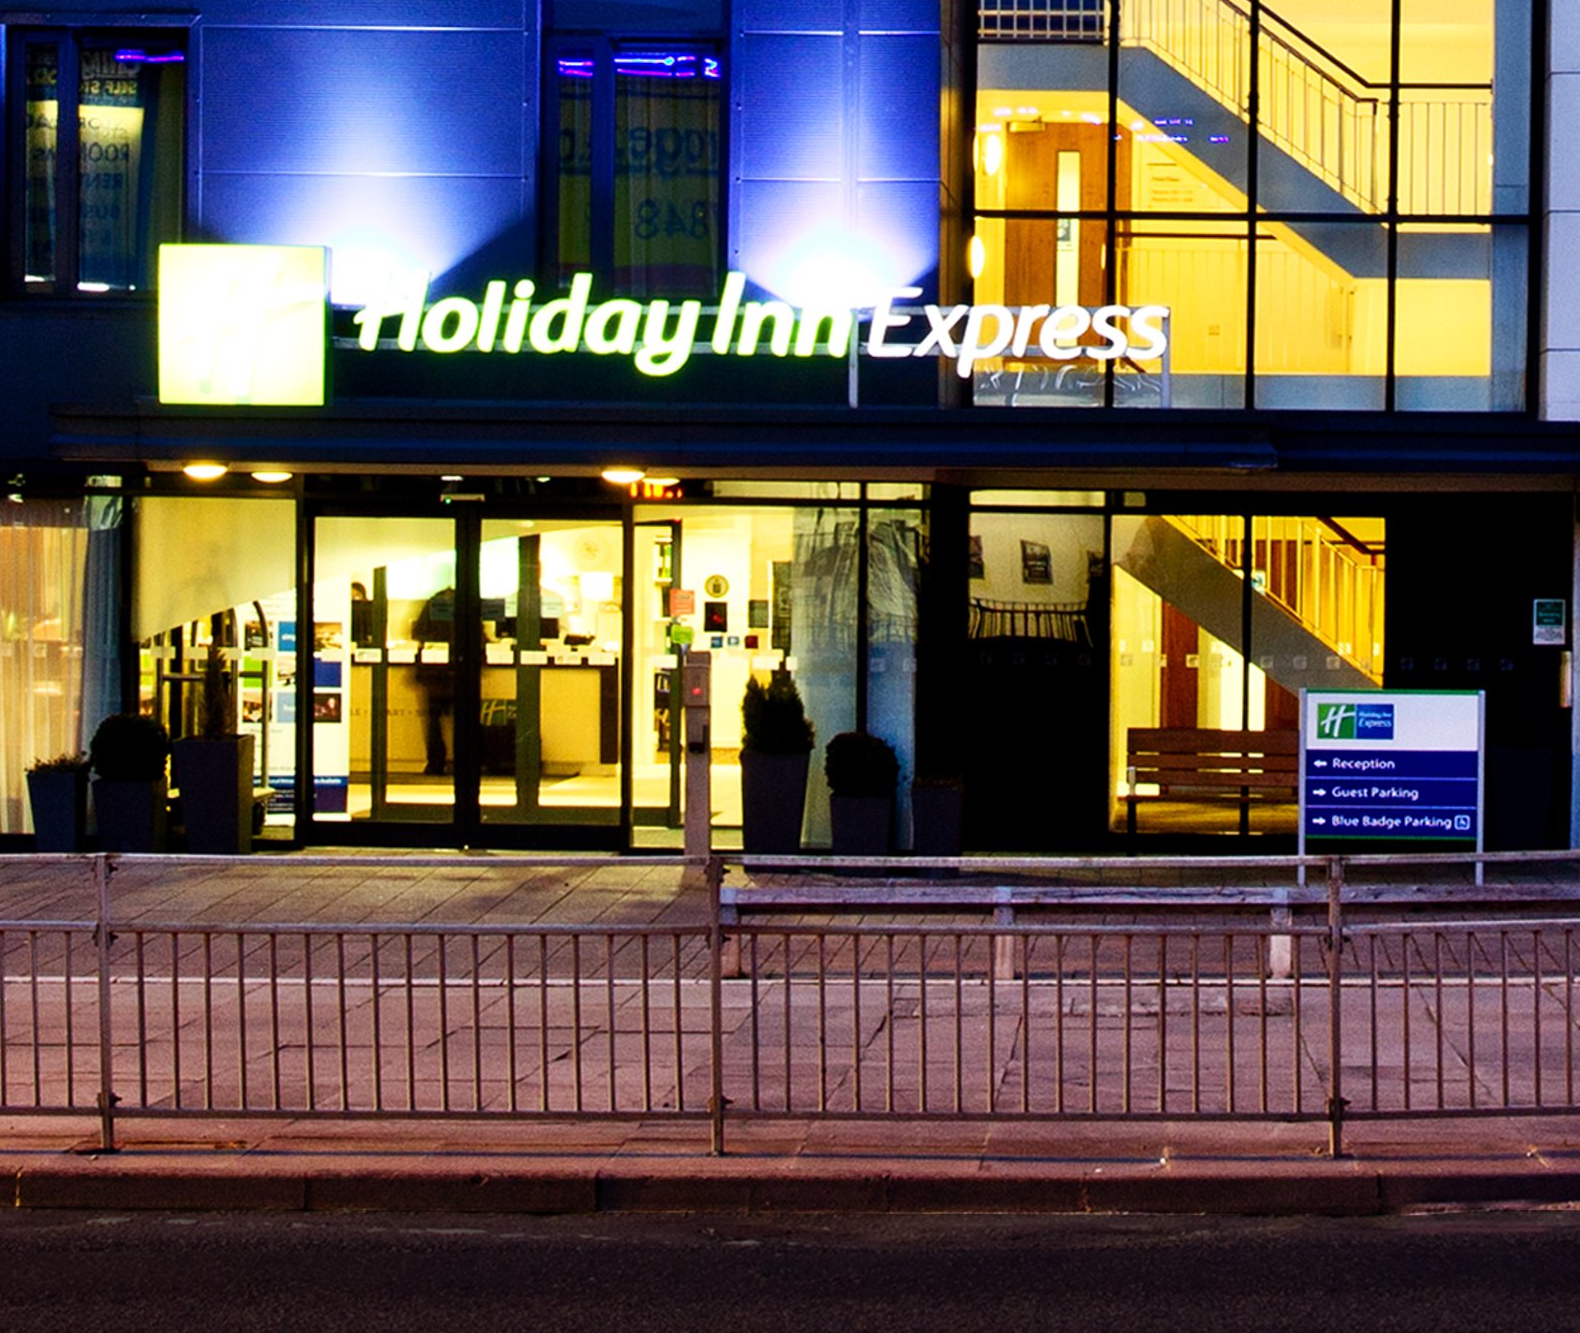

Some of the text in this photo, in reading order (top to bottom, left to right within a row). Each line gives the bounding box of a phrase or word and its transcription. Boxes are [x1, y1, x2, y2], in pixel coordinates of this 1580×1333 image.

[352, 270, 1170, 379] Holiday Inn Express
[1359, 718, 1393, 729] Express
[1332, 758, 1395, 770] Reception
[1332, 786, 1419, 800] Guest Parking
[1332, 815, 1453, 830] Blue Badge Parking
